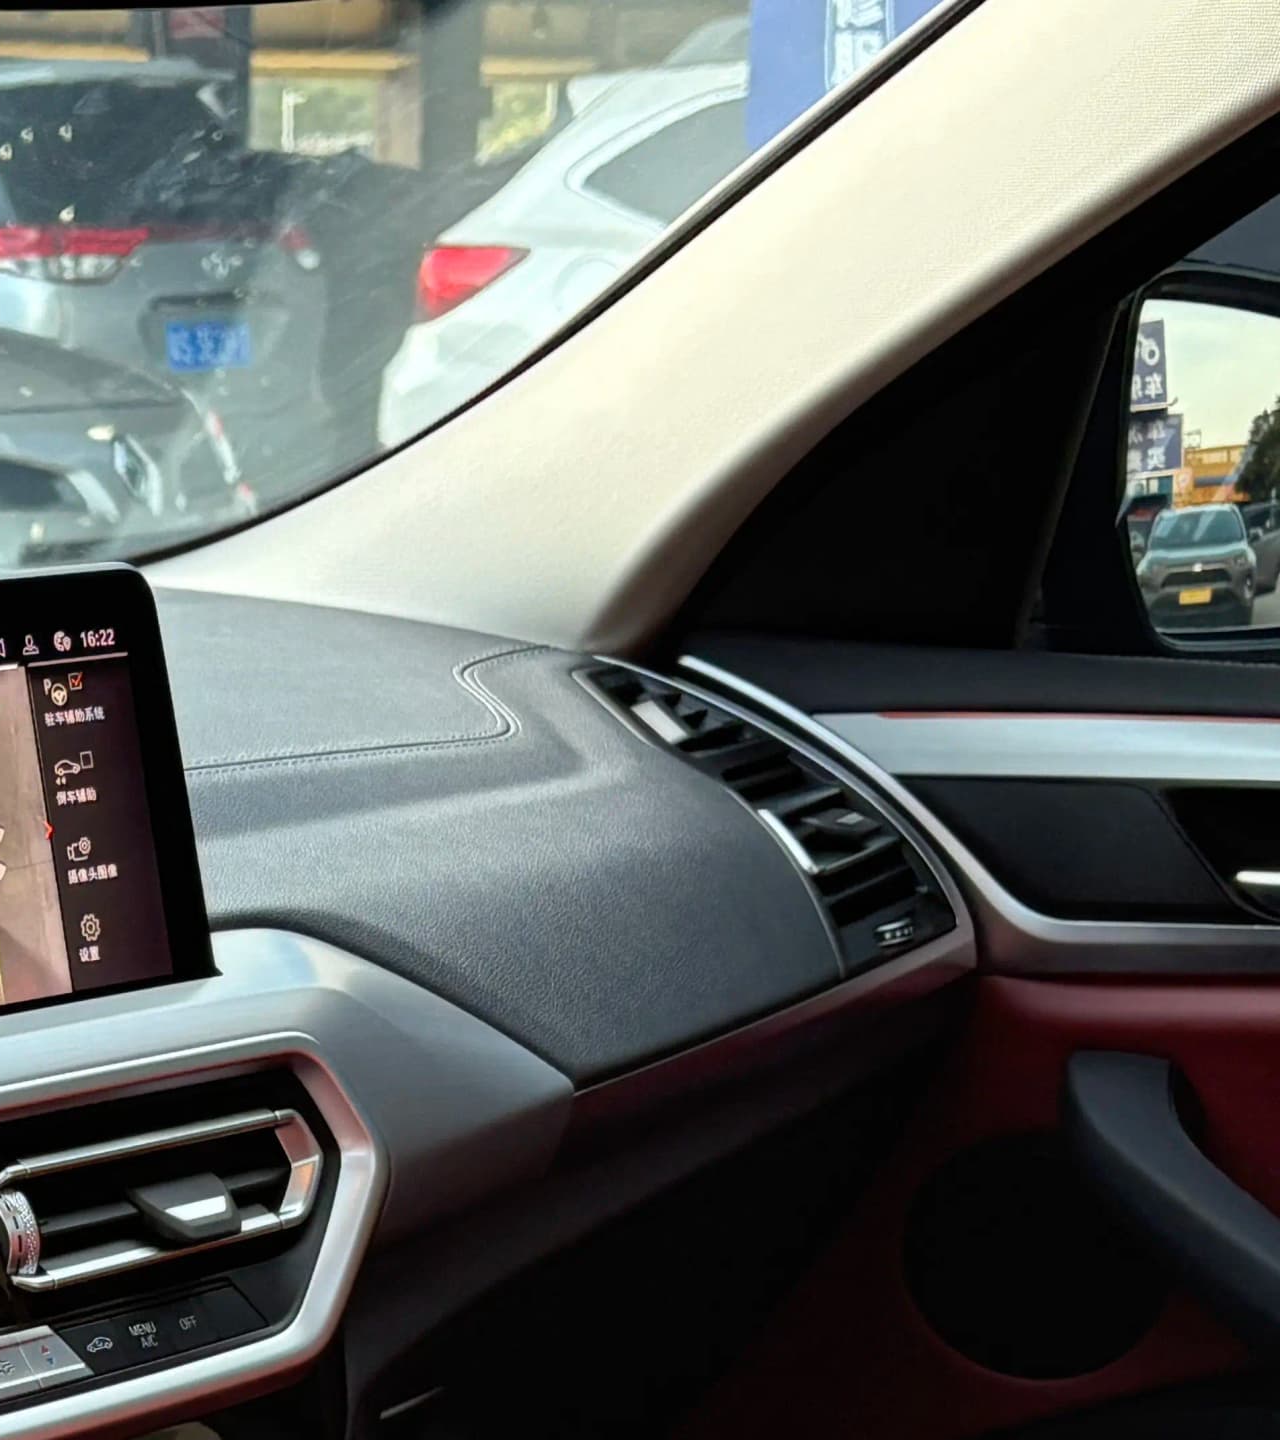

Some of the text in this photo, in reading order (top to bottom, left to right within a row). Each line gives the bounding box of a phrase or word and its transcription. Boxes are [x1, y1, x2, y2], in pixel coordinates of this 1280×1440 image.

[80, 628, 116, 648] 16:22
[128, 1321, 157, 1336] MENU
[179, 1315, 197, 1330] OFF
